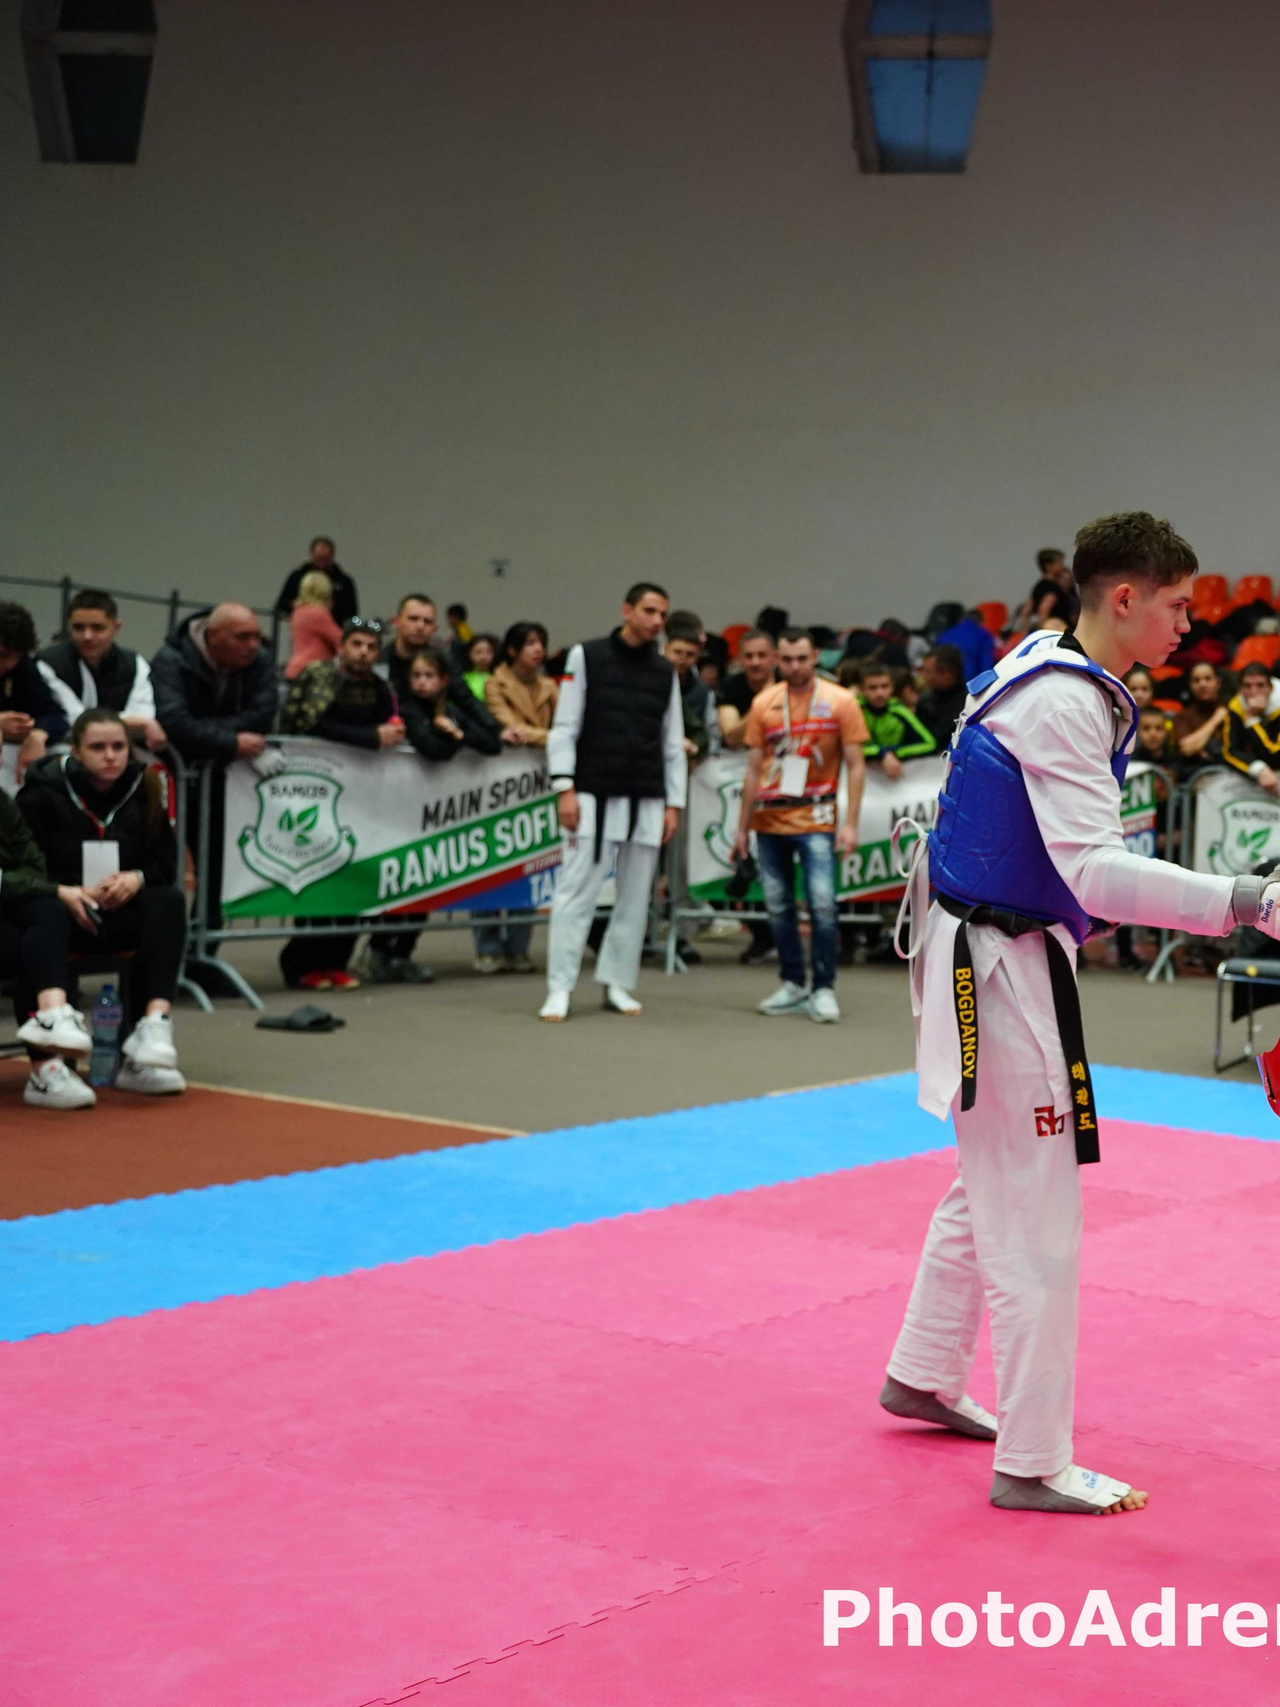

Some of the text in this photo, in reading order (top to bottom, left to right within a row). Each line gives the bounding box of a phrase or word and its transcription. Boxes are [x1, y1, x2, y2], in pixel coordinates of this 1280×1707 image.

[421, 788, 482, 831] MAIN
[378, 826, 489, 900] RAMUS
[494, 801, 560, 858] SOFI
[1261, 899, 1275, 924] Daedo
[955, 967, 976, 1079] BOGDANOV
[1071, 1061, 1096, 1130] 태권도
